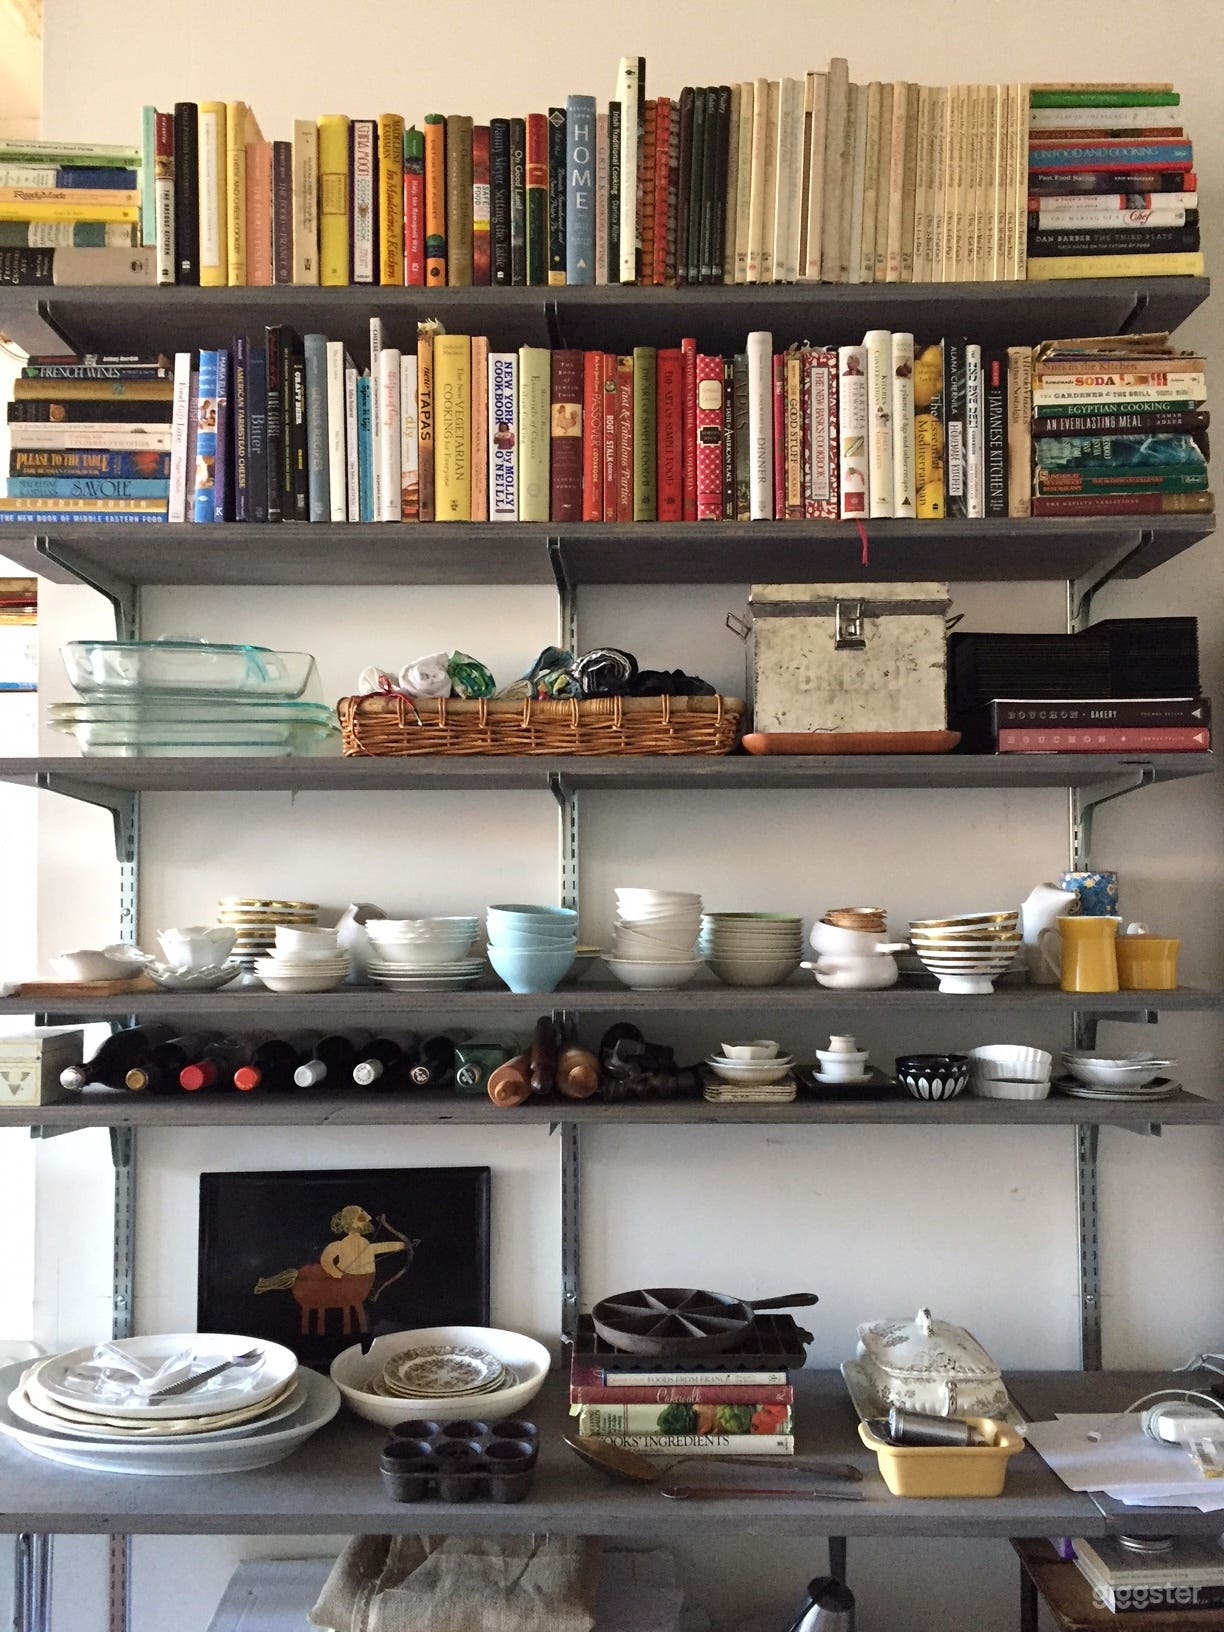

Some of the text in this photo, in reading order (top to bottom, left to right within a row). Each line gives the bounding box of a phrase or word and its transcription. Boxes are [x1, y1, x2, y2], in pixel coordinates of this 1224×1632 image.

[611, 111, 619, 127] Irish
[383, 123, 391, 159] KAMMAN
[392, 120, 401, 164] MADELEINE
[611, 128, 619, 165] Traditional
[387, 169, 398, 177] In
[514, 150, 523, 209] On Good Land
[571, 124, 592, 210] HOME
[611, 166, 619, 195] Cooking
[233, 180, 241, 195] AND
[492, 122, 508, 267] Danny Meyer Setting the Table
[233, 197, 241, 220] CHEESE
[233, 222, 241, 255] COOKERY
[387, 239, 398, 279] Kitchen
[40, 368, 83, 378] FRENCH
[86, 368, 121, 378] WINES
[1042, 362, 1137, 371] Nuts in the Kitchen
[1074, 376, 1117, 386] SODA
[294, 371, 302, 400] CRAFT
[360, 384, 370, 406] Spice
[901, 389, 909, 412] platter
[360, 417, 370, 431] Up!
[420, 390, 431, 441] TAPAS
[443, 383, 453, 438] COOKING
[606, 414, 614, 434] ROOT
[641, 368, 649, 477] THE ART OF SIMPLE FOOD
[901, 413, 910, 422] of
[988, 396, 1002, 447] JAPANESE
[1046, 421, 1057, 431] AN
[1060, 417, 1116, 430] EVERLASTING
[1119, 416, 1142, 427] MEAL
[1068, 402, 1170, 415] EGYPTIAN COOKING
[237, 409, 245, 456] FARMSTEAD
[251, 414, 264, 454] Bitter
[311, 386, 323, 471] GENIUS RECIPES
[455, 400, 465, 481] VEGETARIAN
[504, 362, 514, 506] NEW YORK by MOLLY
[665, 370, 673, 485] THE ART OF SIMPLE FOOD
[789, 398, 798, 464] GOOD STUFF
[815, 371, 825, 480] THE NEW BASICS COOKBOOK
[901, 422, 910, 435] figs
[930, 394, 940, 470] The Essential
[606, 440, 614, 462] STALK
[619, 384, 631, 505] Fast & Fabulous Parties
[950, 424, 961, 493] HOMEMADE KITCHEN
[16, 453, 109, 472] PLEASE TO THE TABLE
[238, 458, 246, 488] CHEESE
[442, 452, 451, 487] Everyone
[917, 420, 928, 506] Mediterranean
[990, 450, 1003, 497] KITCHEN
[71, 481, 132, 497] SAVOIE
[496, 450, 504, 507] O'NEILL
[902, 467, 910, 492] recipes
[0, 514, 162, 522] THE NEW BOOK OF MIDDLE EASTERN FOOD
[1007, 711, 1079, 720] BOUCHON
[1090, 710, 1117, 719] BAKERY
[1007, 736, 1106, 744] BOUCHON
[656, 1387, 702, 1404] Cakewalk
[643, 1436, 729, 1447] INGREDIENTS
